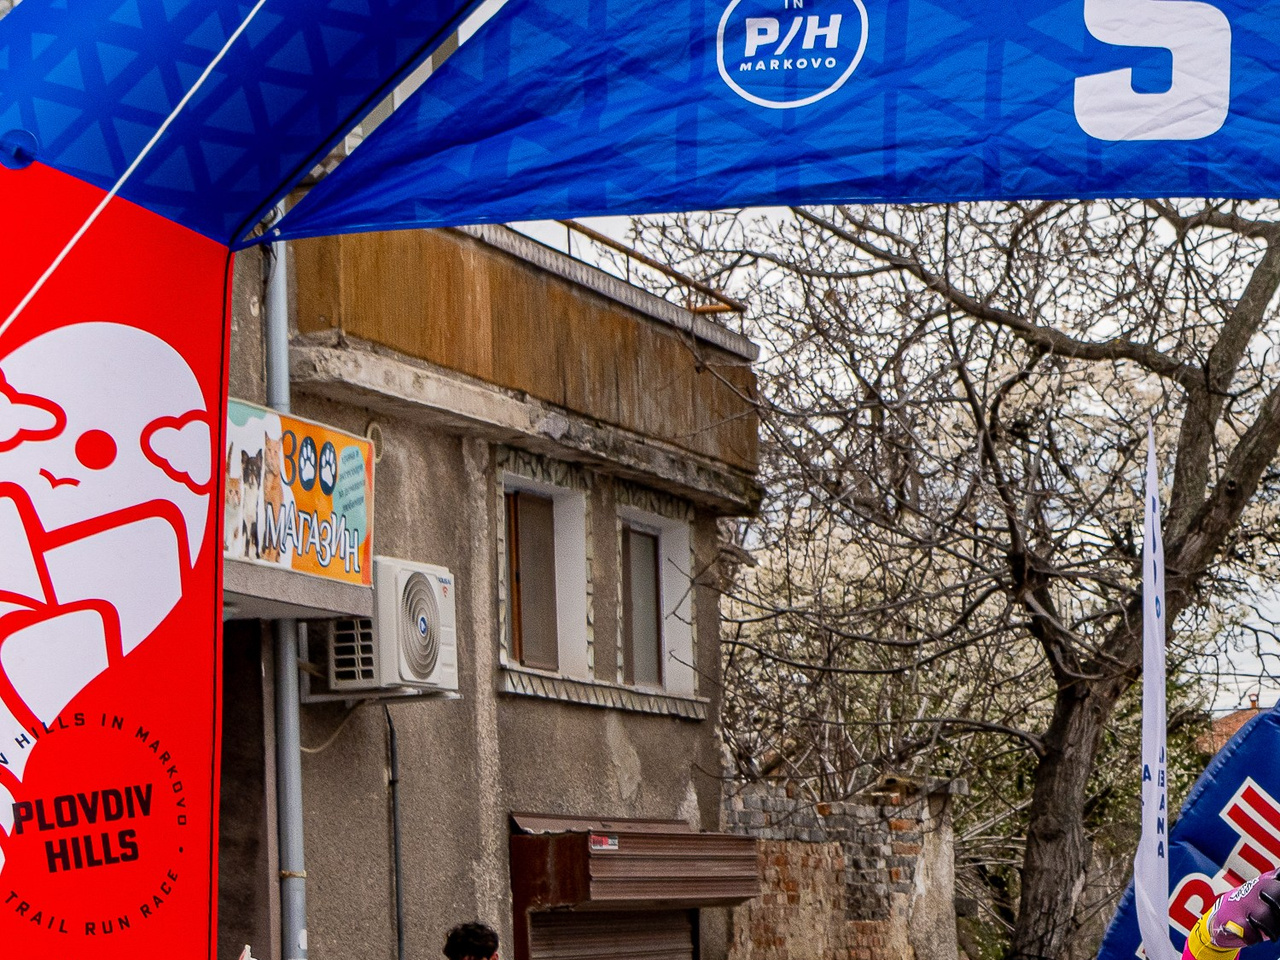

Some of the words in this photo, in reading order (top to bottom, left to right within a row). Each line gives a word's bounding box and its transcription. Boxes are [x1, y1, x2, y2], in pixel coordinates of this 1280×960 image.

[744, 14, 842, 57] P/H
[739, 57, 837, 71] MARKOVO
[265, 501, 361, 573] МАГАЗИН
[14, 712, 85, 749] HILLS
[101, 713, 125, 731] IN
[135, 725, 187, 826] MARKOVO
[12, 783, 154, 835] PLOVDIV
[44, 829, 140, 874] HILLS
[5, 891, 69, 934] TRAIL
[85, 915, 131, 936] RUN
[140, 868, 179, 918] RACE
